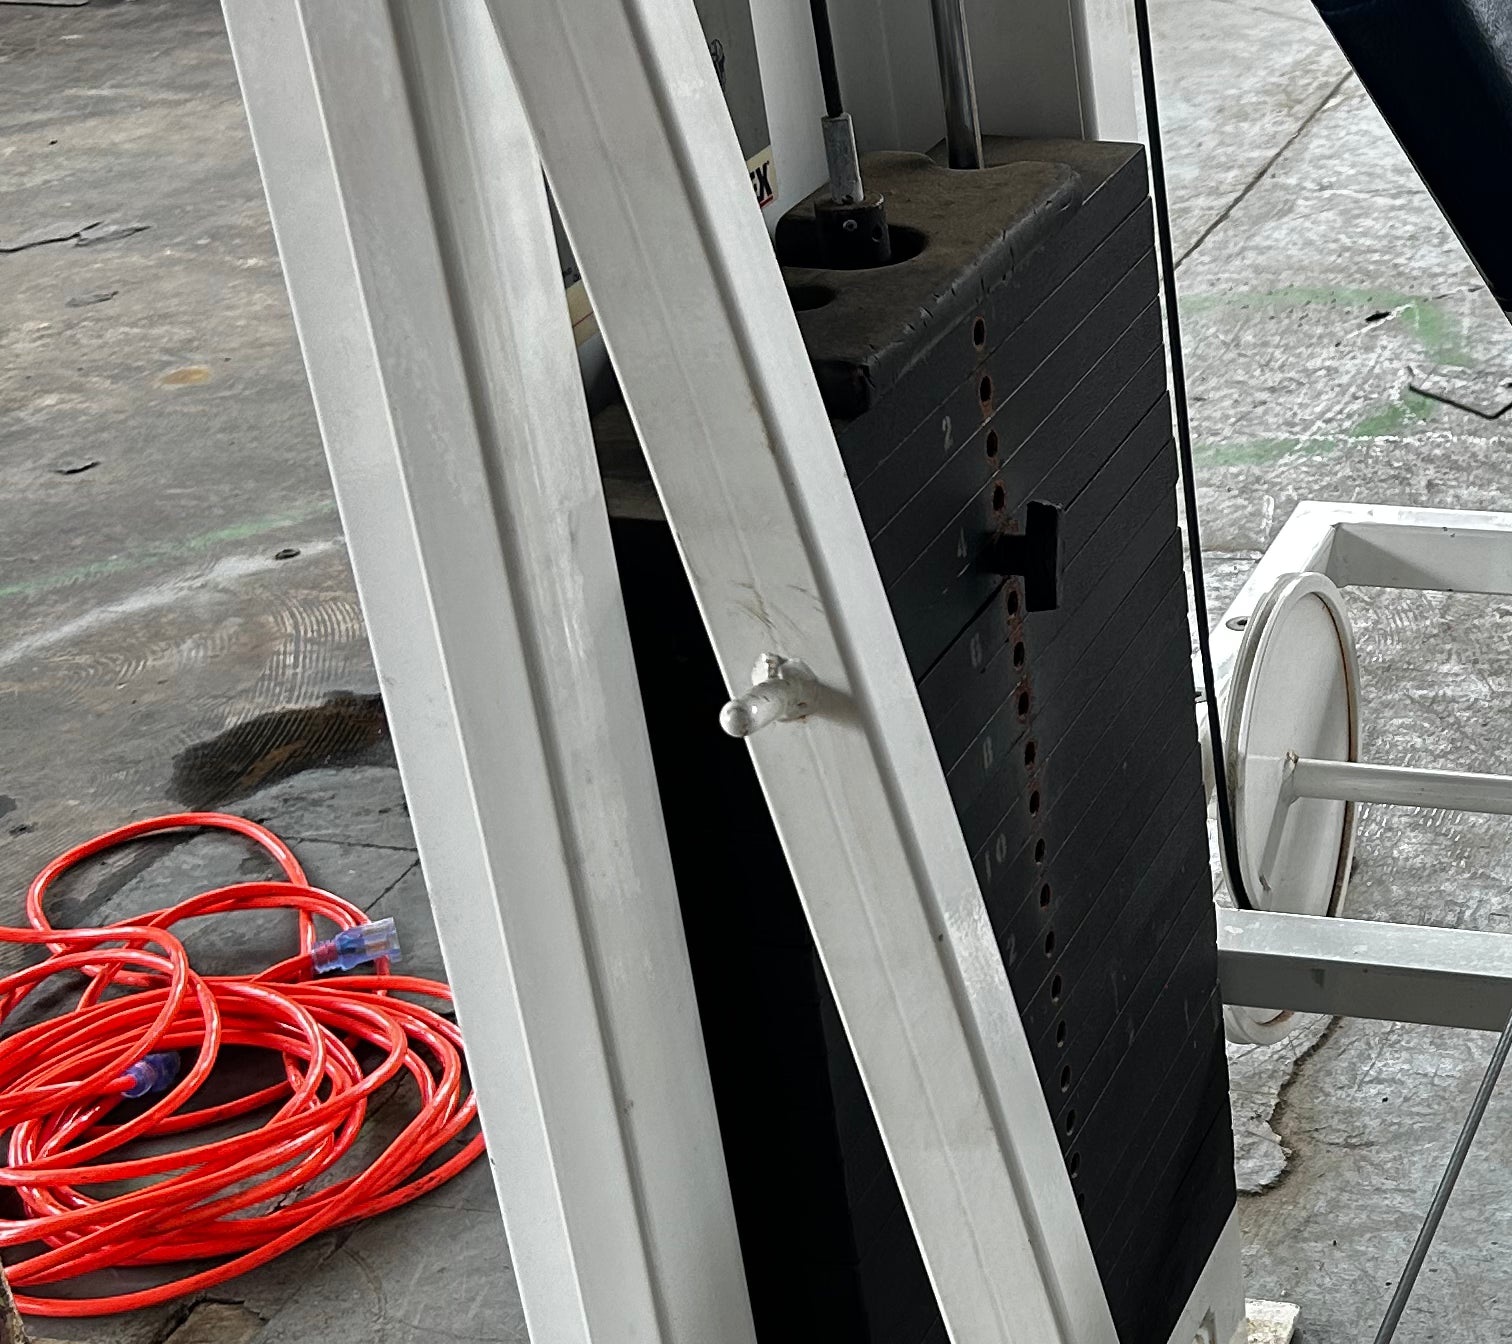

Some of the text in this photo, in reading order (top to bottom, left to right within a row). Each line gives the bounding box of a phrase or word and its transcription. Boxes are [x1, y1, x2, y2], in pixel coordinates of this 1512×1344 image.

[942, 416, 954, 452] 2
[957, 527, 968, 558] 4
[985, 833, 1007, 883] 10
